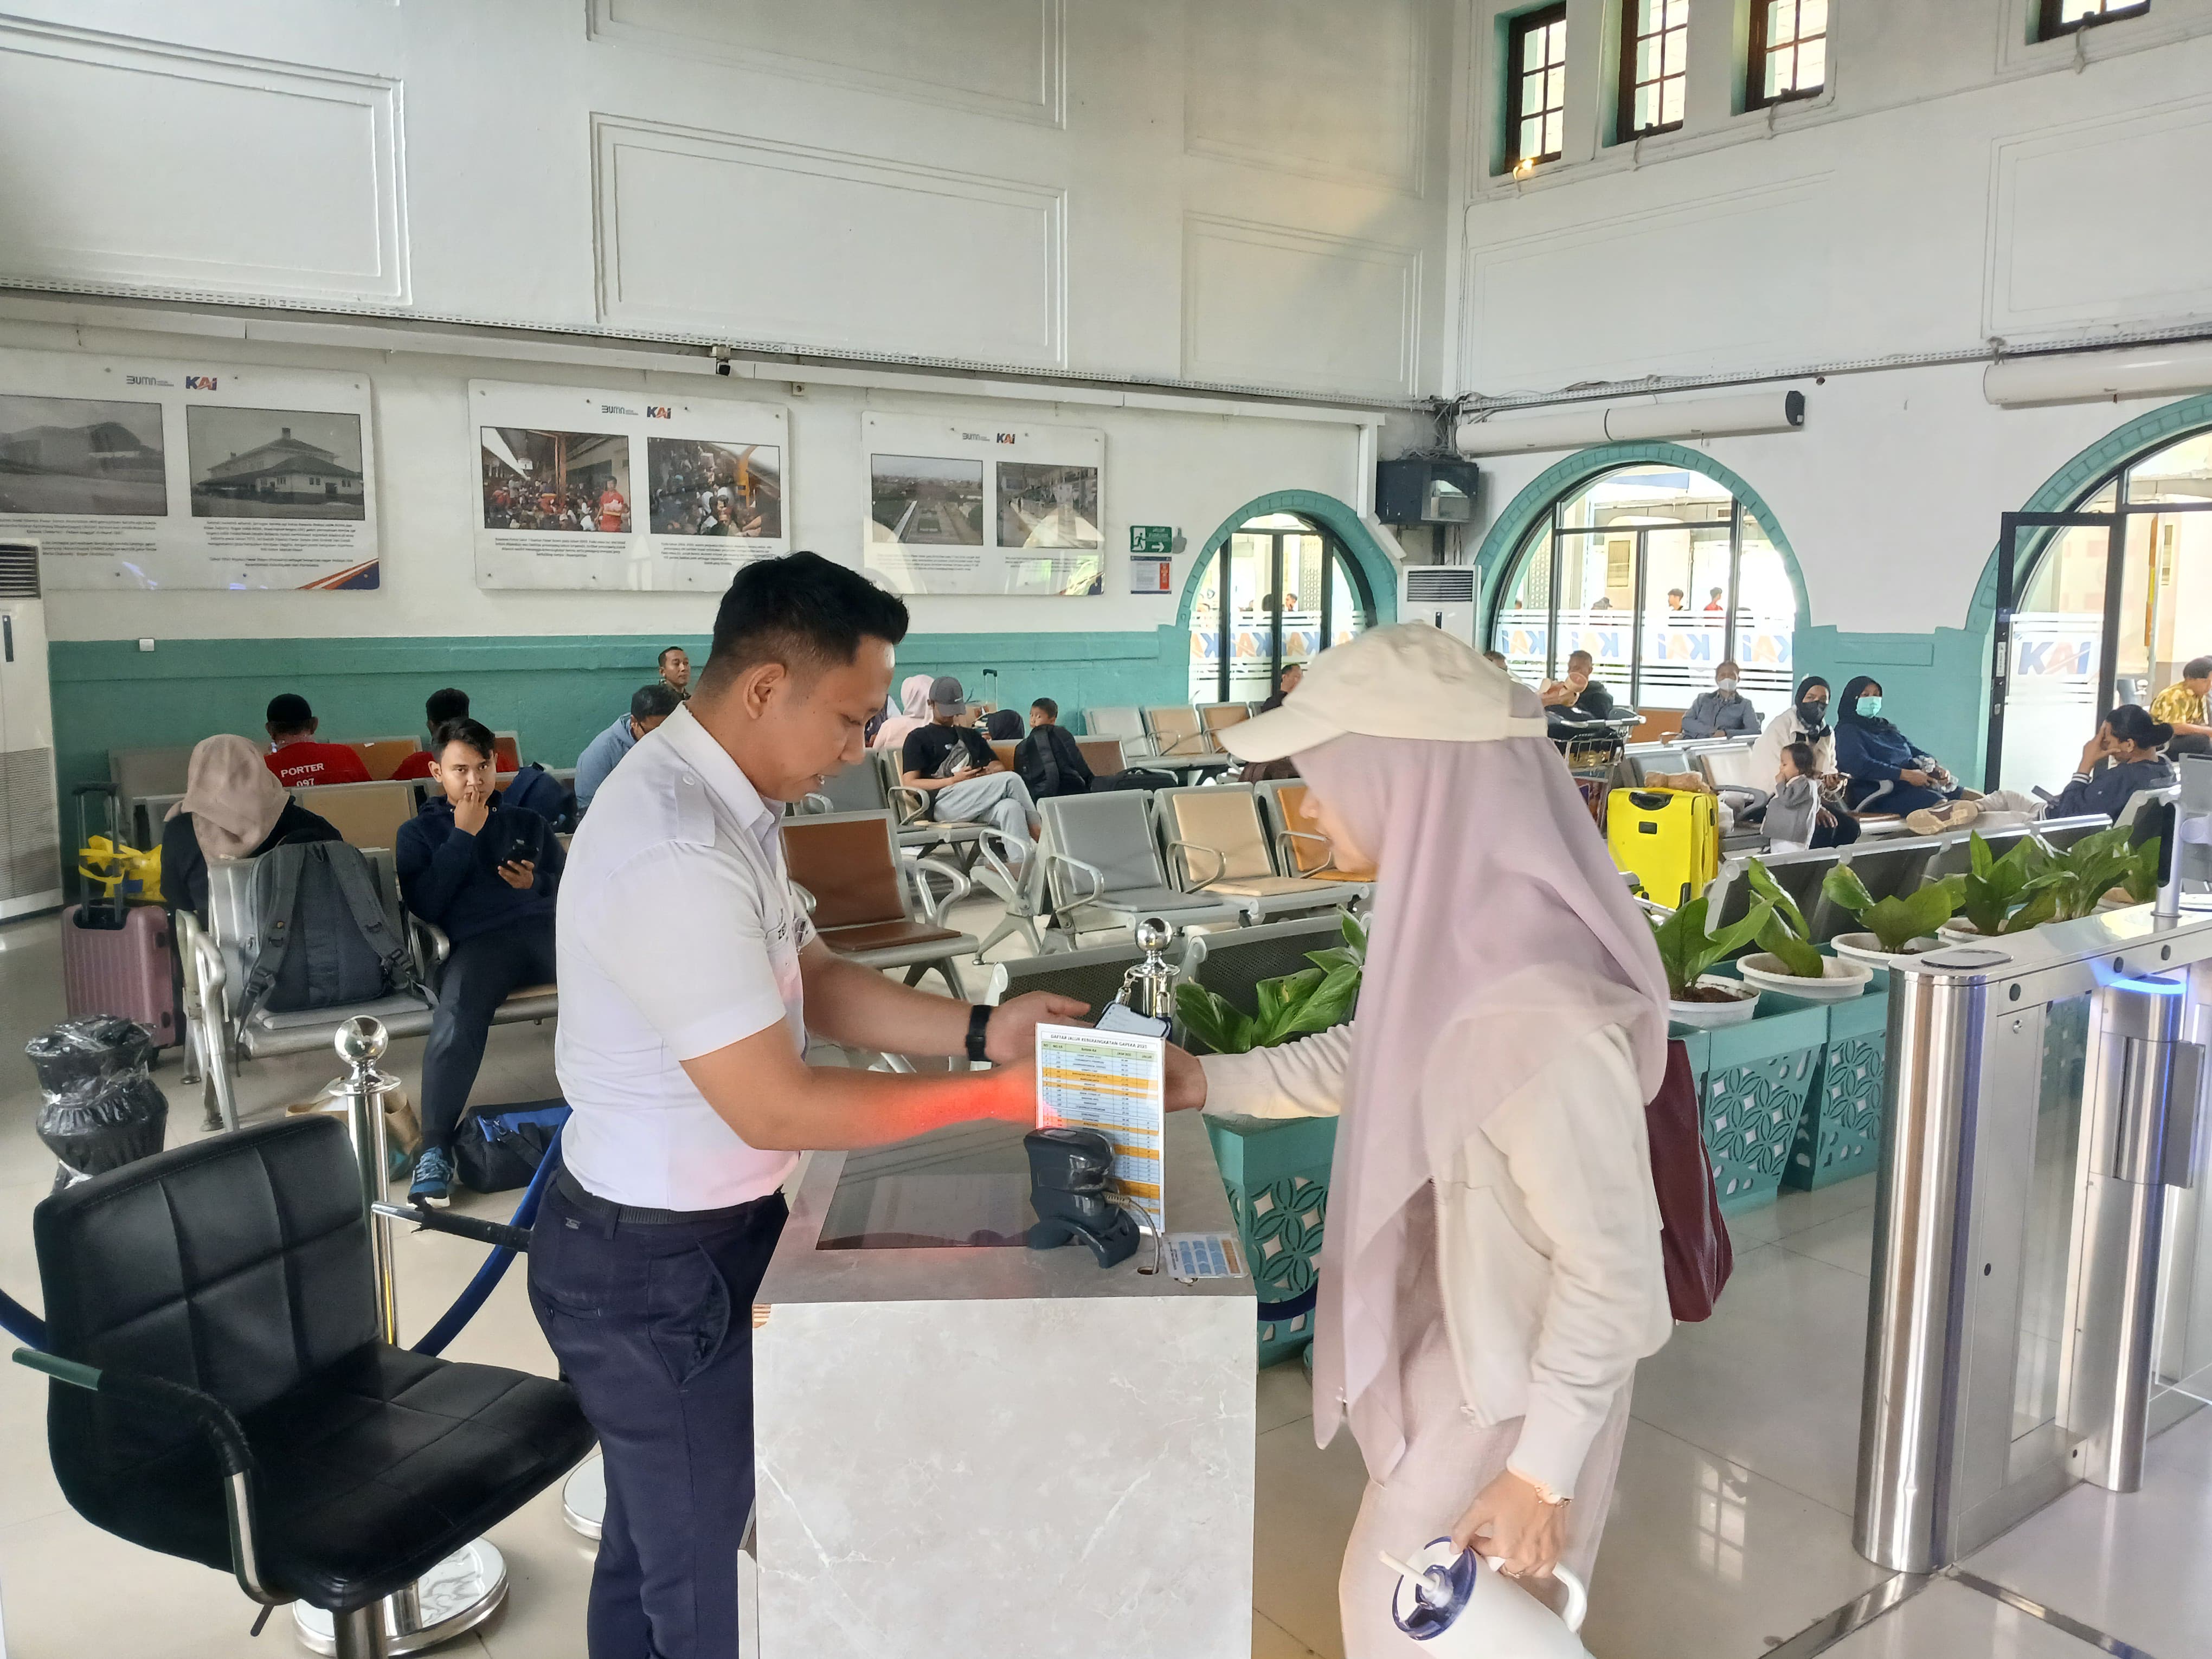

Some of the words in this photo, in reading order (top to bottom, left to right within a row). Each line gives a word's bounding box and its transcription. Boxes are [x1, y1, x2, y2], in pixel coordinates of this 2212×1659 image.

[185, 376, 217, 391] KAI
[647, 406, 671, 419] KAI
[996, 433, 1015, 444] KAI
[2018, 641, 2091, 676] KAI
[280, 763, 325, 777] PORTER
